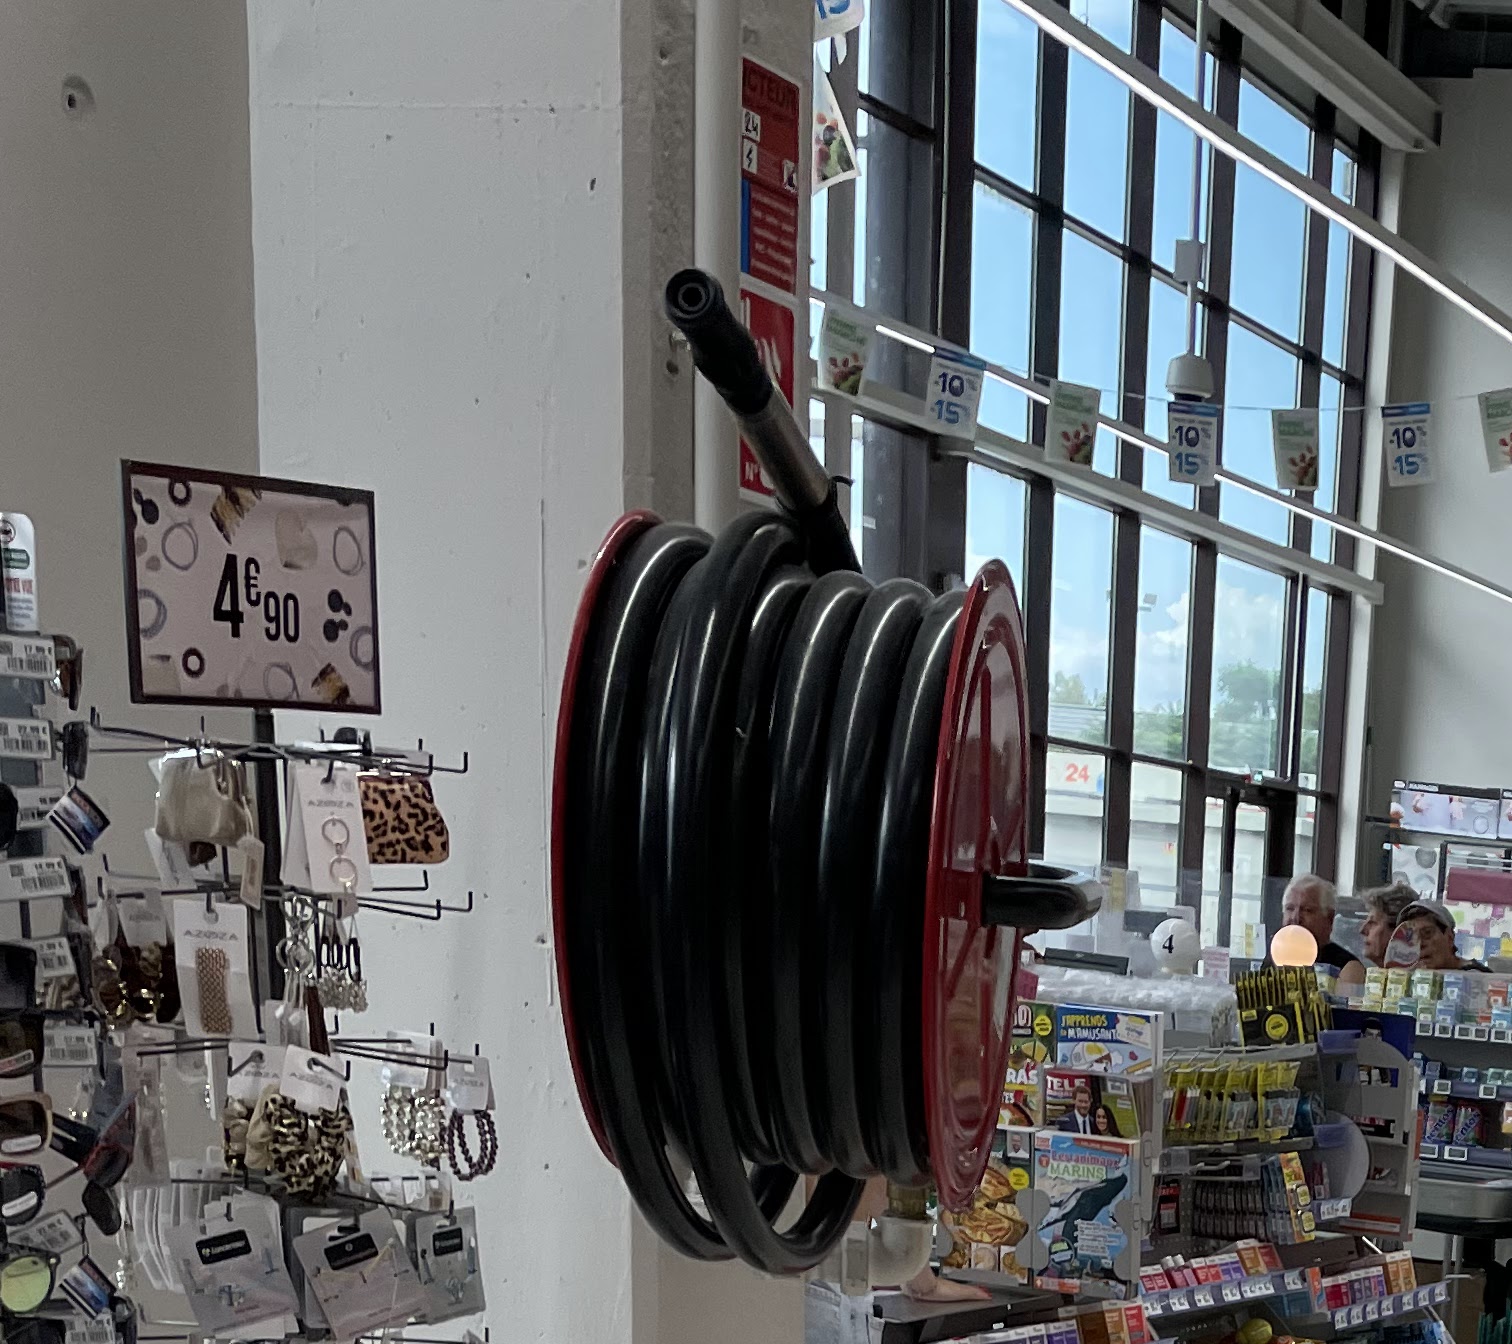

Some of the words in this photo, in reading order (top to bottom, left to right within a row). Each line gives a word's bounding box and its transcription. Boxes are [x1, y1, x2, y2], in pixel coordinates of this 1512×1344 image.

[1065, 763, 1089, 784] 24
[1162, 934, 1174, 954] 4
[1005, 1067, 1038, 1085] RAS
[1050, 1162, 1105, 1179] MARINS
